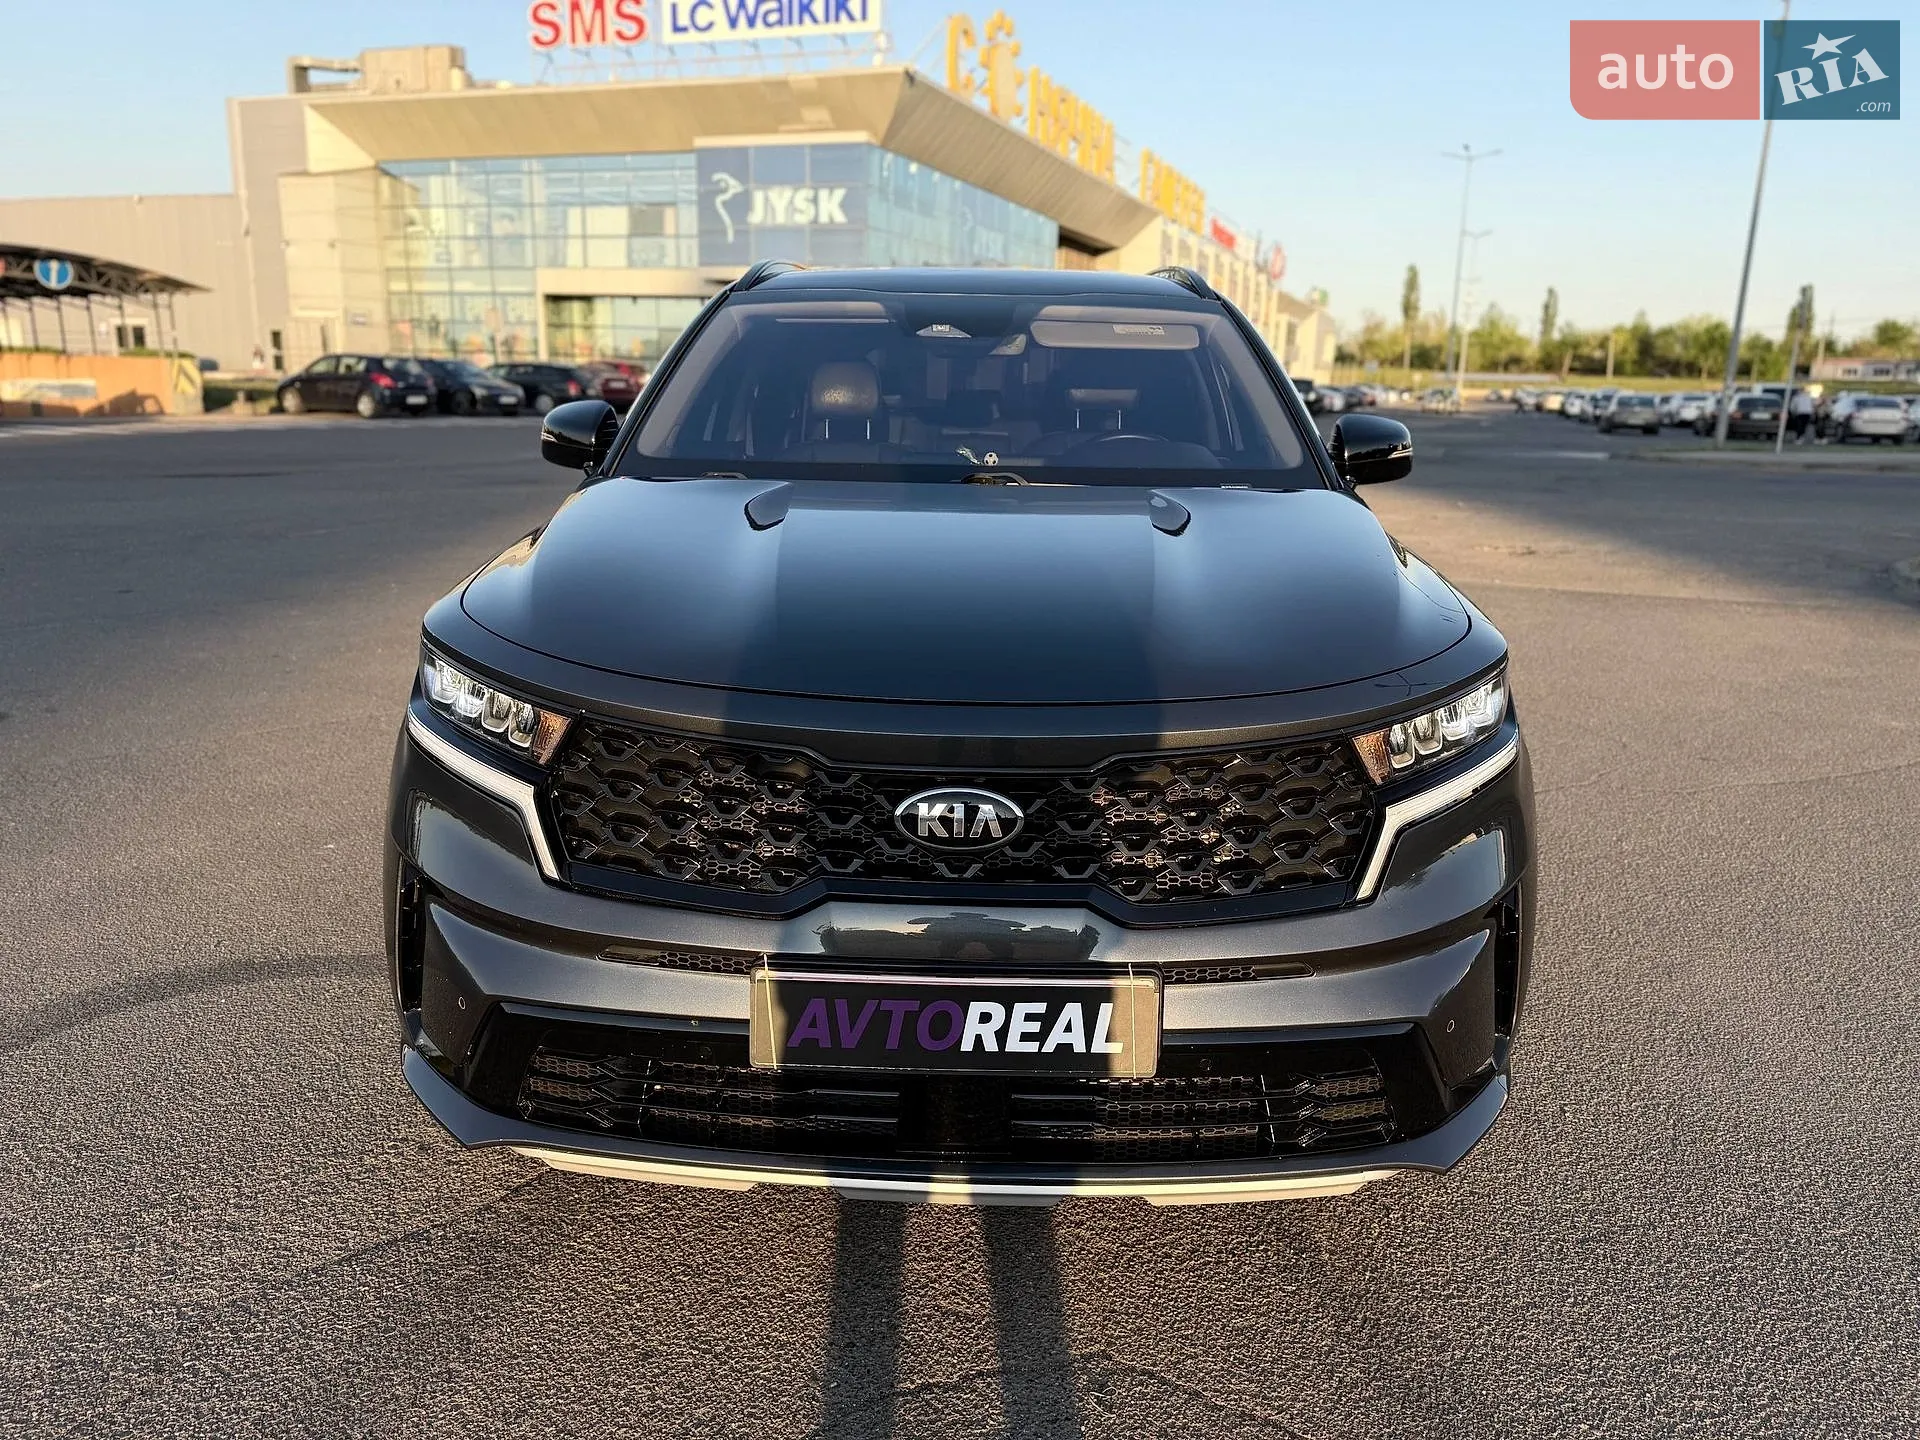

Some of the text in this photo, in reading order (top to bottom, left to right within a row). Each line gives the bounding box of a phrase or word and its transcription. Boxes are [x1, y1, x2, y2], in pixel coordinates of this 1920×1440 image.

[530, 0, 646, 47] SMS
[671, 0, 868, 33] LC Waikiki
[747, 186, 848, 225] JYSK
[917, 802, 1003, 837] KIA
[786, 997, 1124, 1055] AVTOREAL
